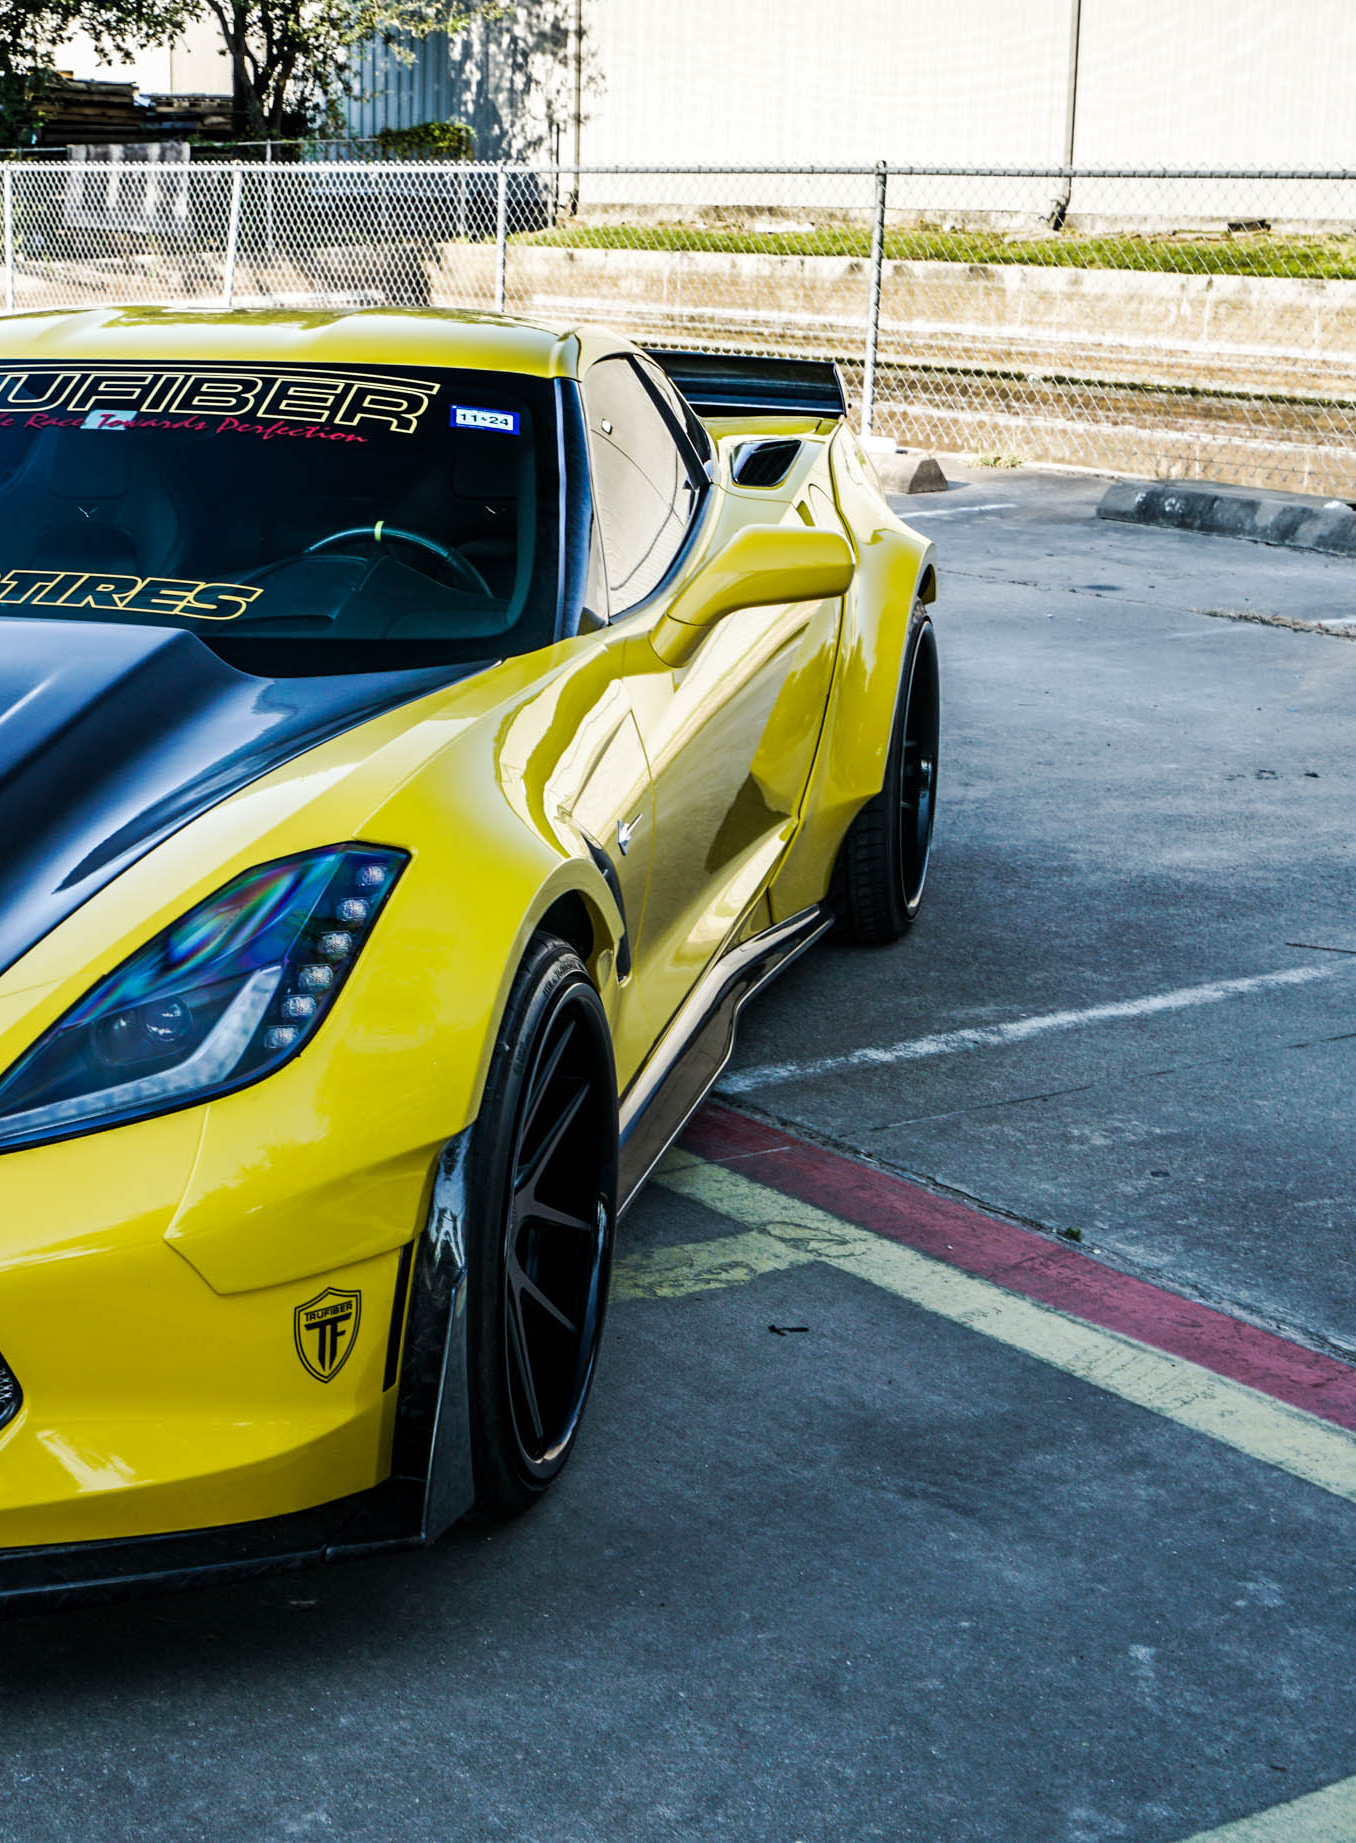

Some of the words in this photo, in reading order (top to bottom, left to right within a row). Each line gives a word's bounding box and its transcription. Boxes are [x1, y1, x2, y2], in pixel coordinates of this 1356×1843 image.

[23, 412, 86, 430] Race
[97, 413, 208, 431] Towards
[215, 416, 370, 443] Perfection
[304, 1300, 353, 1322] TRUFIBER
